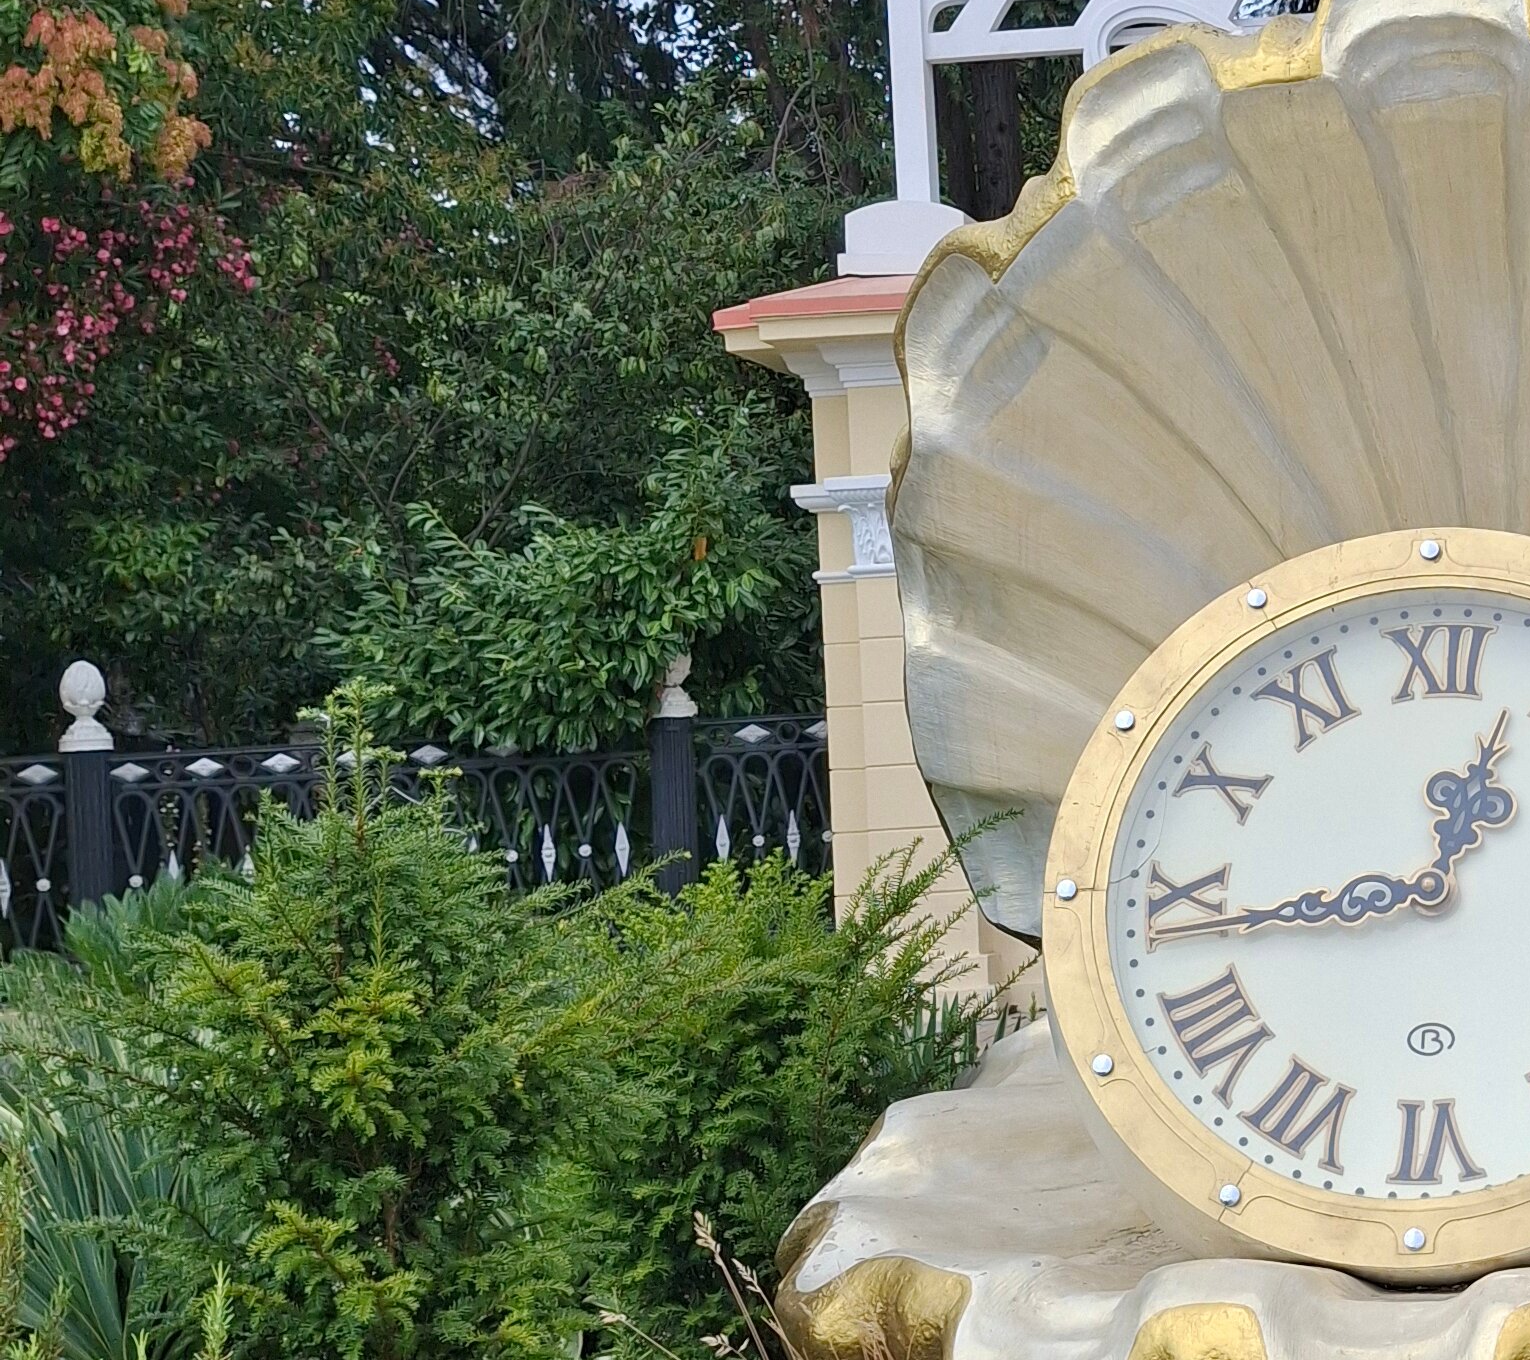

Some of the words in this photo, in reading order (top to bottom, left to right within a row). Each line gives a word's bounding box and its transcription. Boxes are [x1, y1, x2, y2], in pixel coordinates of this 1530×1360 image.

[1250, 645, 1362, 752] XI
[1381, 624, 1499, 701] XII
[1172, 742, 1273, 826] X
[1156, 962, 1276, 1109] VIII
[1236, 1053, 1357, 1175] VII
[1385, 1098, 1487, 1184] VI
